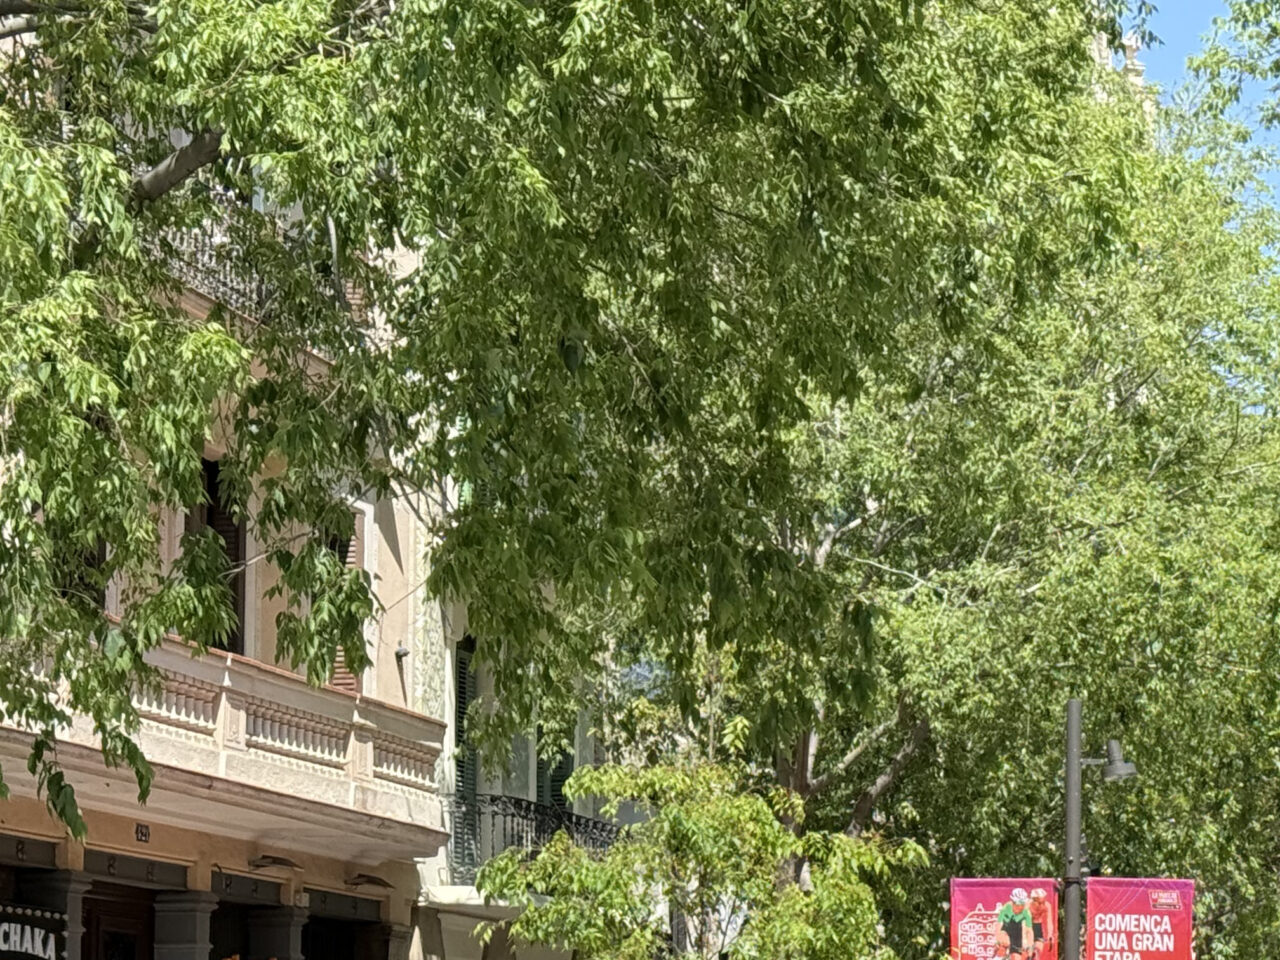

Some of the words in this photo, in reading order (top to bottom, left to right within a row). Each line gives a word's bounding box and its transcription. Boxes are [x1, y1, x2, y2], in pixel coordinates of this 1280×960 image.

[1094, 913, 1172, 936] COMENÇA
[1094, 932, 1129, 950] UNA
[1132, 933, 1175, 952] GRAN
